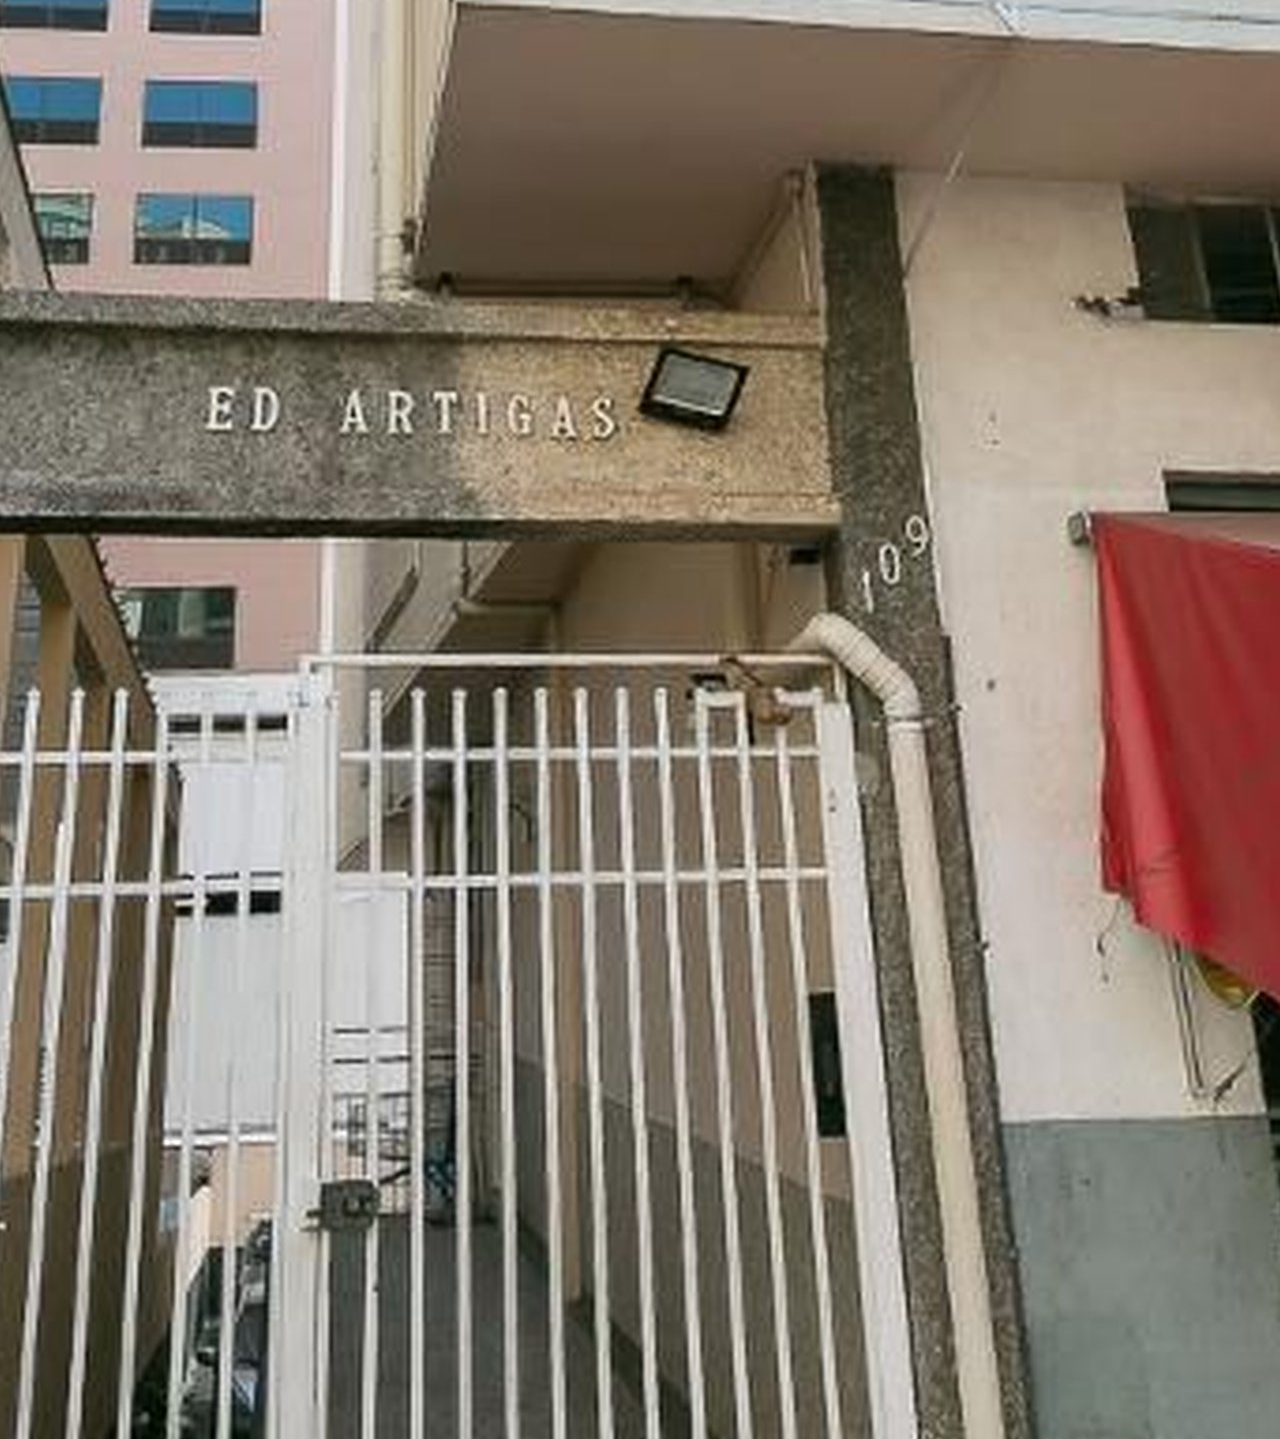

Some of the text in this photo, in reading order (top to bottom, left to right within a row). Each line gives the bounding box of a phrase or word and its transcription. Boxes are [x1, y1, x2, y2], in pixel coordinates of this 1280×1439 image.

[204, 386, 619, 441] ED ARTIGAS
[861, 514, 929, 615] 109
